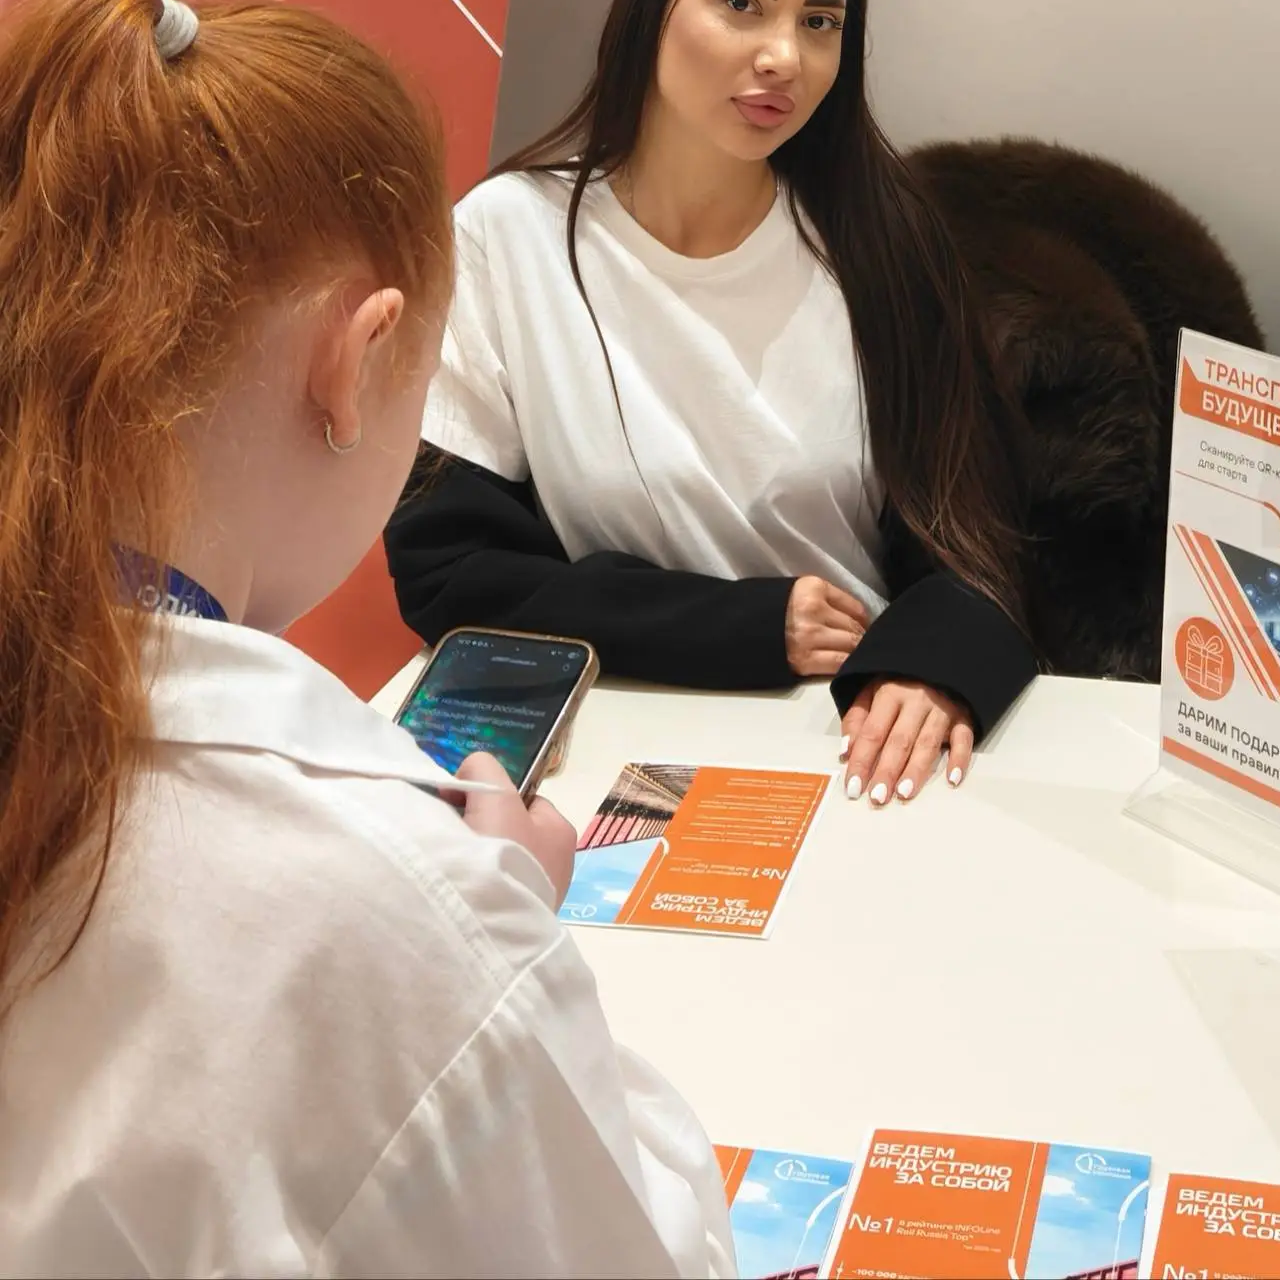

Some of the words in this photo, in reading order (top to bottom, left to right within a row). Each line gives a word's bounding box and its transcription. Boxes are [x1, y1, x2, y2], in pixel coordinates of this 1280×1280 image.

[1199, 440, 1255, 468] Сканируйте
[1198, 458, 1215, 470] для
[1217, 465, 1248, 483] старта
[1177, 701, 1227, 735] ДАРИМ
[1177, 722, 1192, 737] за
[1195, 730, 1229, 756] ваши
[654, 892, 719, 905] СОБОЙ
[724, 897, 750, 908] ЗА
[650, 901, 769, 918] ИНДУСТРИЮ
[695, 913, 765, 927] ВЕДЕМ
[873, 1142, 956, 1159] ВЕДЕМ
[869, 1156, 1012, 1178] ИНДУСТРИЮ
[893, 1171, 924, 1185] ЗА
[931, 1173, 1011, 1192] СОБОЙ
[1178, 1188, 1264, 1209] ВЕДЕМ
[906, 1220, 953, 1231] рейтинге
[1203, 1220, 1236, 1236] ЗА
